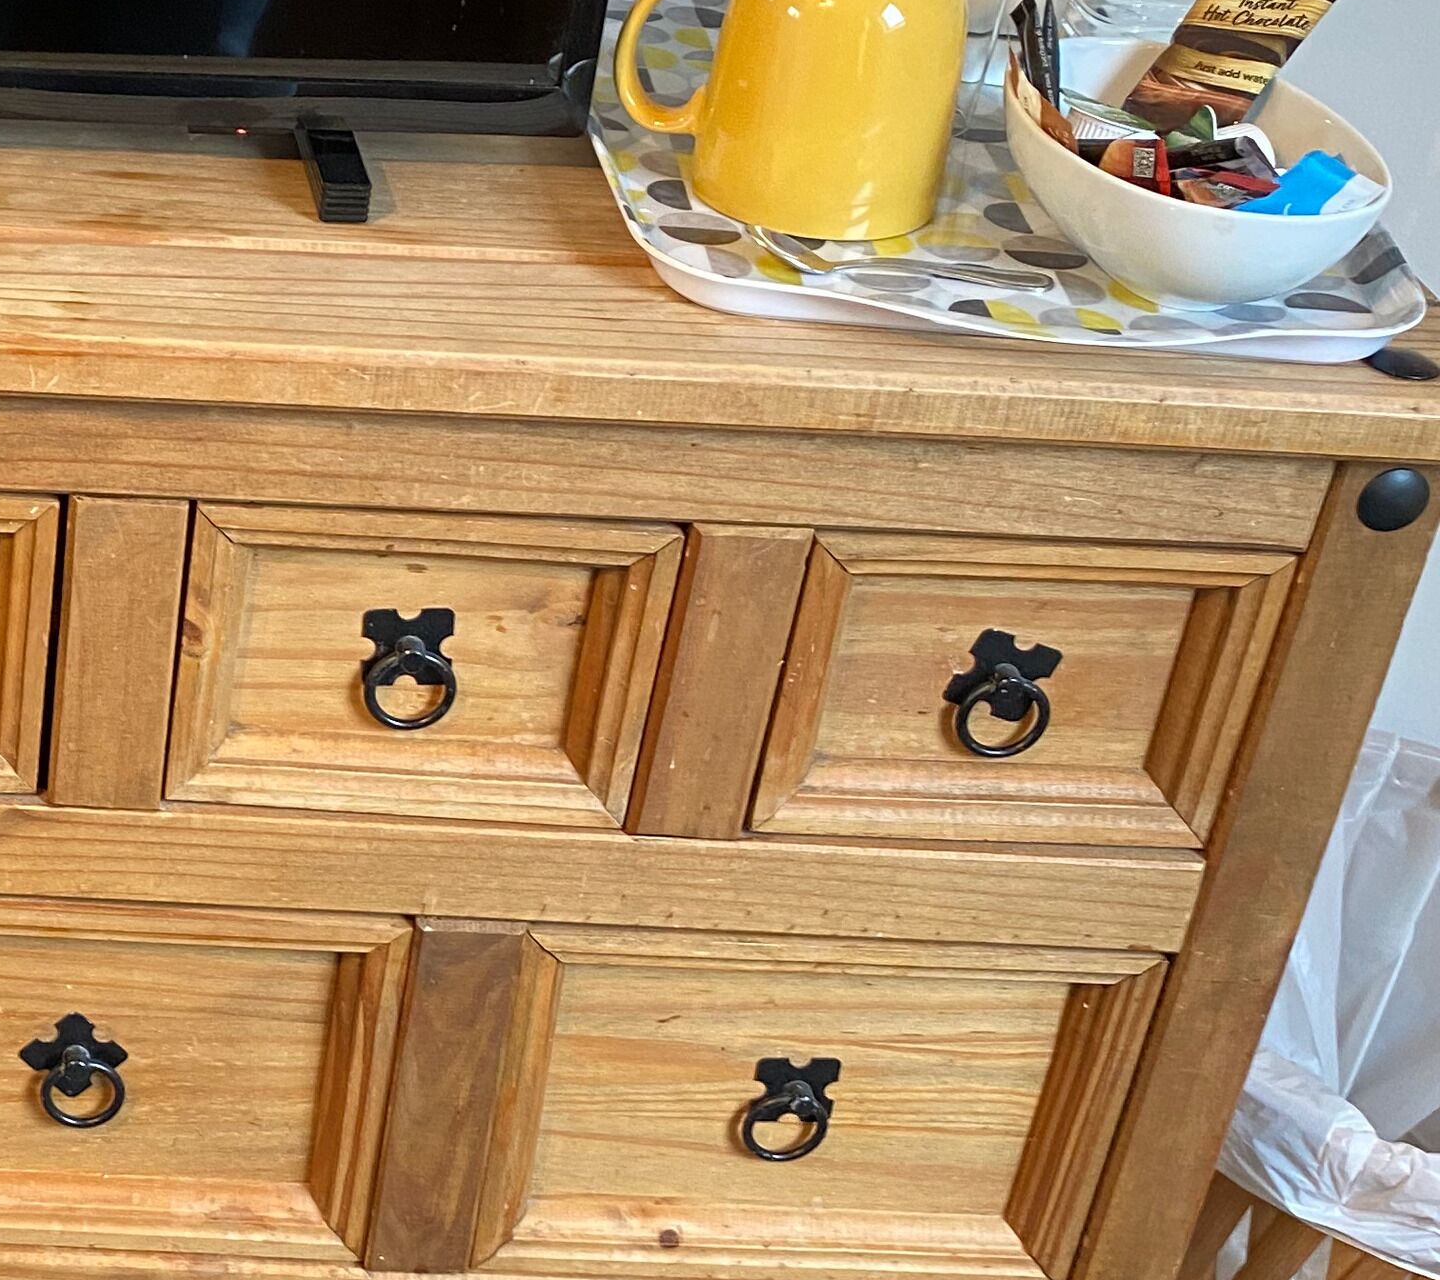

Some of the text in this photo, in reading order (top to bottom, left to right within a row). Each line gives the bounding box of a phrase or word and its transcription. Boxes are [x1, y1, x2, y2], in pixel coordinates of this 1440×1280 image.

[1202, 4, 1312, 30] Hot Chocolate
[1217, 69, 1241, 79] add
[1243, 73, 1269, 86] wate
